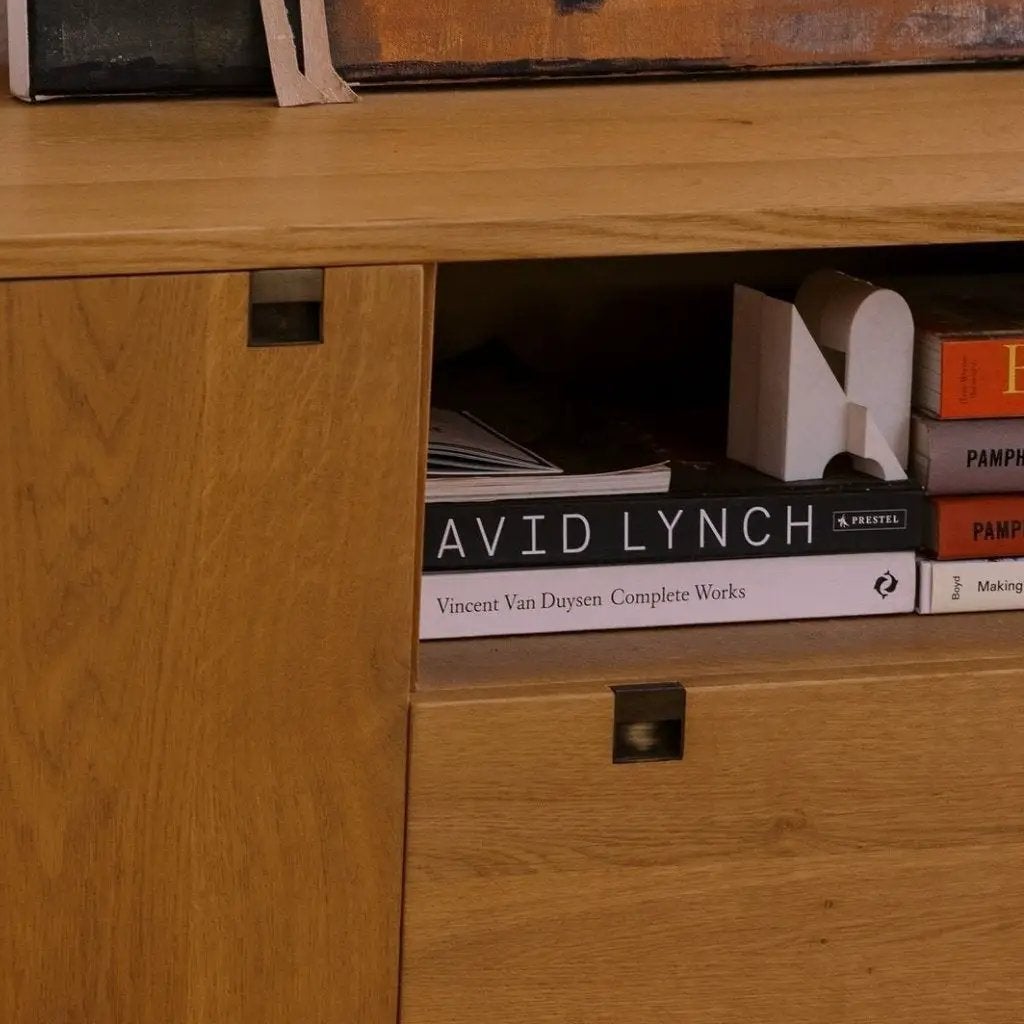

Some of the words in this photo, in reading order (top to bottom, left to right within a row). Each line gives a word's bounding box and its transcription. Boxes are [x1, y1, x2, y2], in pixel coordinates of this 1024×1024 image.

[967, 448, 1024, 467] PAMPH
[851, 514, 899, 525] PRESTEL
[437, 513, 591, 558] AVID
[623, 504, 813, 551] LYNCH
[973, 520, 1024, 541] PAMP
[951, 576, 963, 600] Boyd
[977, 580, 1023, 594] Making
[437, 597, 499, 614] Vincent
[504, 593, 536, 610] Van
[541, 591, 602, 613] Duysen
[611, 585, 690, 608] Complete
[694, 583, 747, 601] Works
